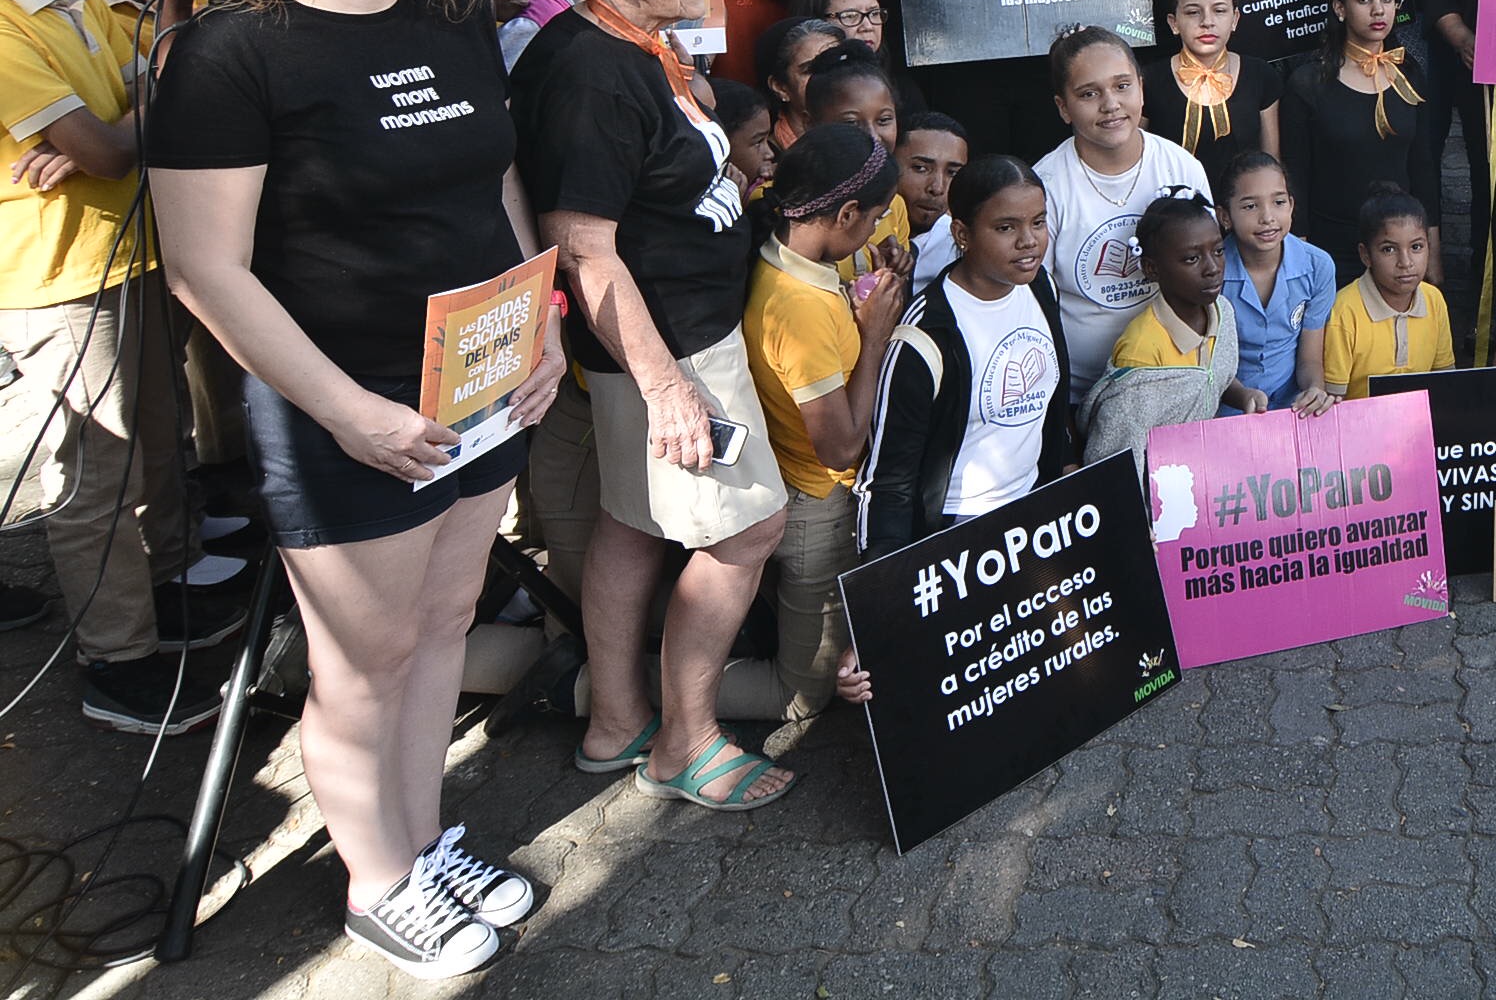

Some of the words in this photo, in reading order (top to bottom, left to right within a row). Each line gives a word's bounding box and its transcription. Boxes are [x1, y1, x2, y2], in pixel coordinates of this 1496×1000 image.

[1115, 23, 1154, 42] MOVIDA
[1265, 13, 1283, 26] de
[369, 65, 435, 89] WOMEN
[380, 100, 475, 130] MOUNTAINS
[391, 86, 440, 107] MOVE
[459, 322, 477, 336] LAS
[477, 290, 532, 332] DEUDAS
[1106, 286, 1151, 303] CEPMAJ
[457, 307, 529, 355] SOCIALES
[465, 347, 489, 368] DEL
[493, 326, 520, 355] PAÍS
[485, 344, 514, 372] LAS
[453, 354, 522, 405] MUJERES
[998, 400, 1043, 418] CEPMAJ
[1213, 463, 1393, 527] #YoParo
[1442, 495, 1455, 513] Y
[1461, 490, 1494, 511] SIN
[1180, 539, 1263, 572] Porque
[1268, 526, 1341, 559] quiero
[1347, 510, 1428, 543] avanzar
[913, 504, 1100, 618] #YoParo
[1185, 571, 1235, 600] más
[1240, 557, 1303, 590] hacia
[1309, 552, 1329, 578] la
[1334, 533, 1429, 574] igualdad
[944, 622, 983, 656] Por
[989, 604, 1011, 632] el
[1016, 567, 1096, 618] acceso
[1403, 594, 1447, 613] MOVIDA
[941, 674, 958, 695] a
[964, 628, 1045, 682] crédito
[1051, 611, 1079, 636] de
[1083, 591, 1113, 619] las
[947, 666, 1040, 731] mujeres
[1044, 625, 1120, 677] rurales.
[1133, 670, 1175, 702] MOVIDA
